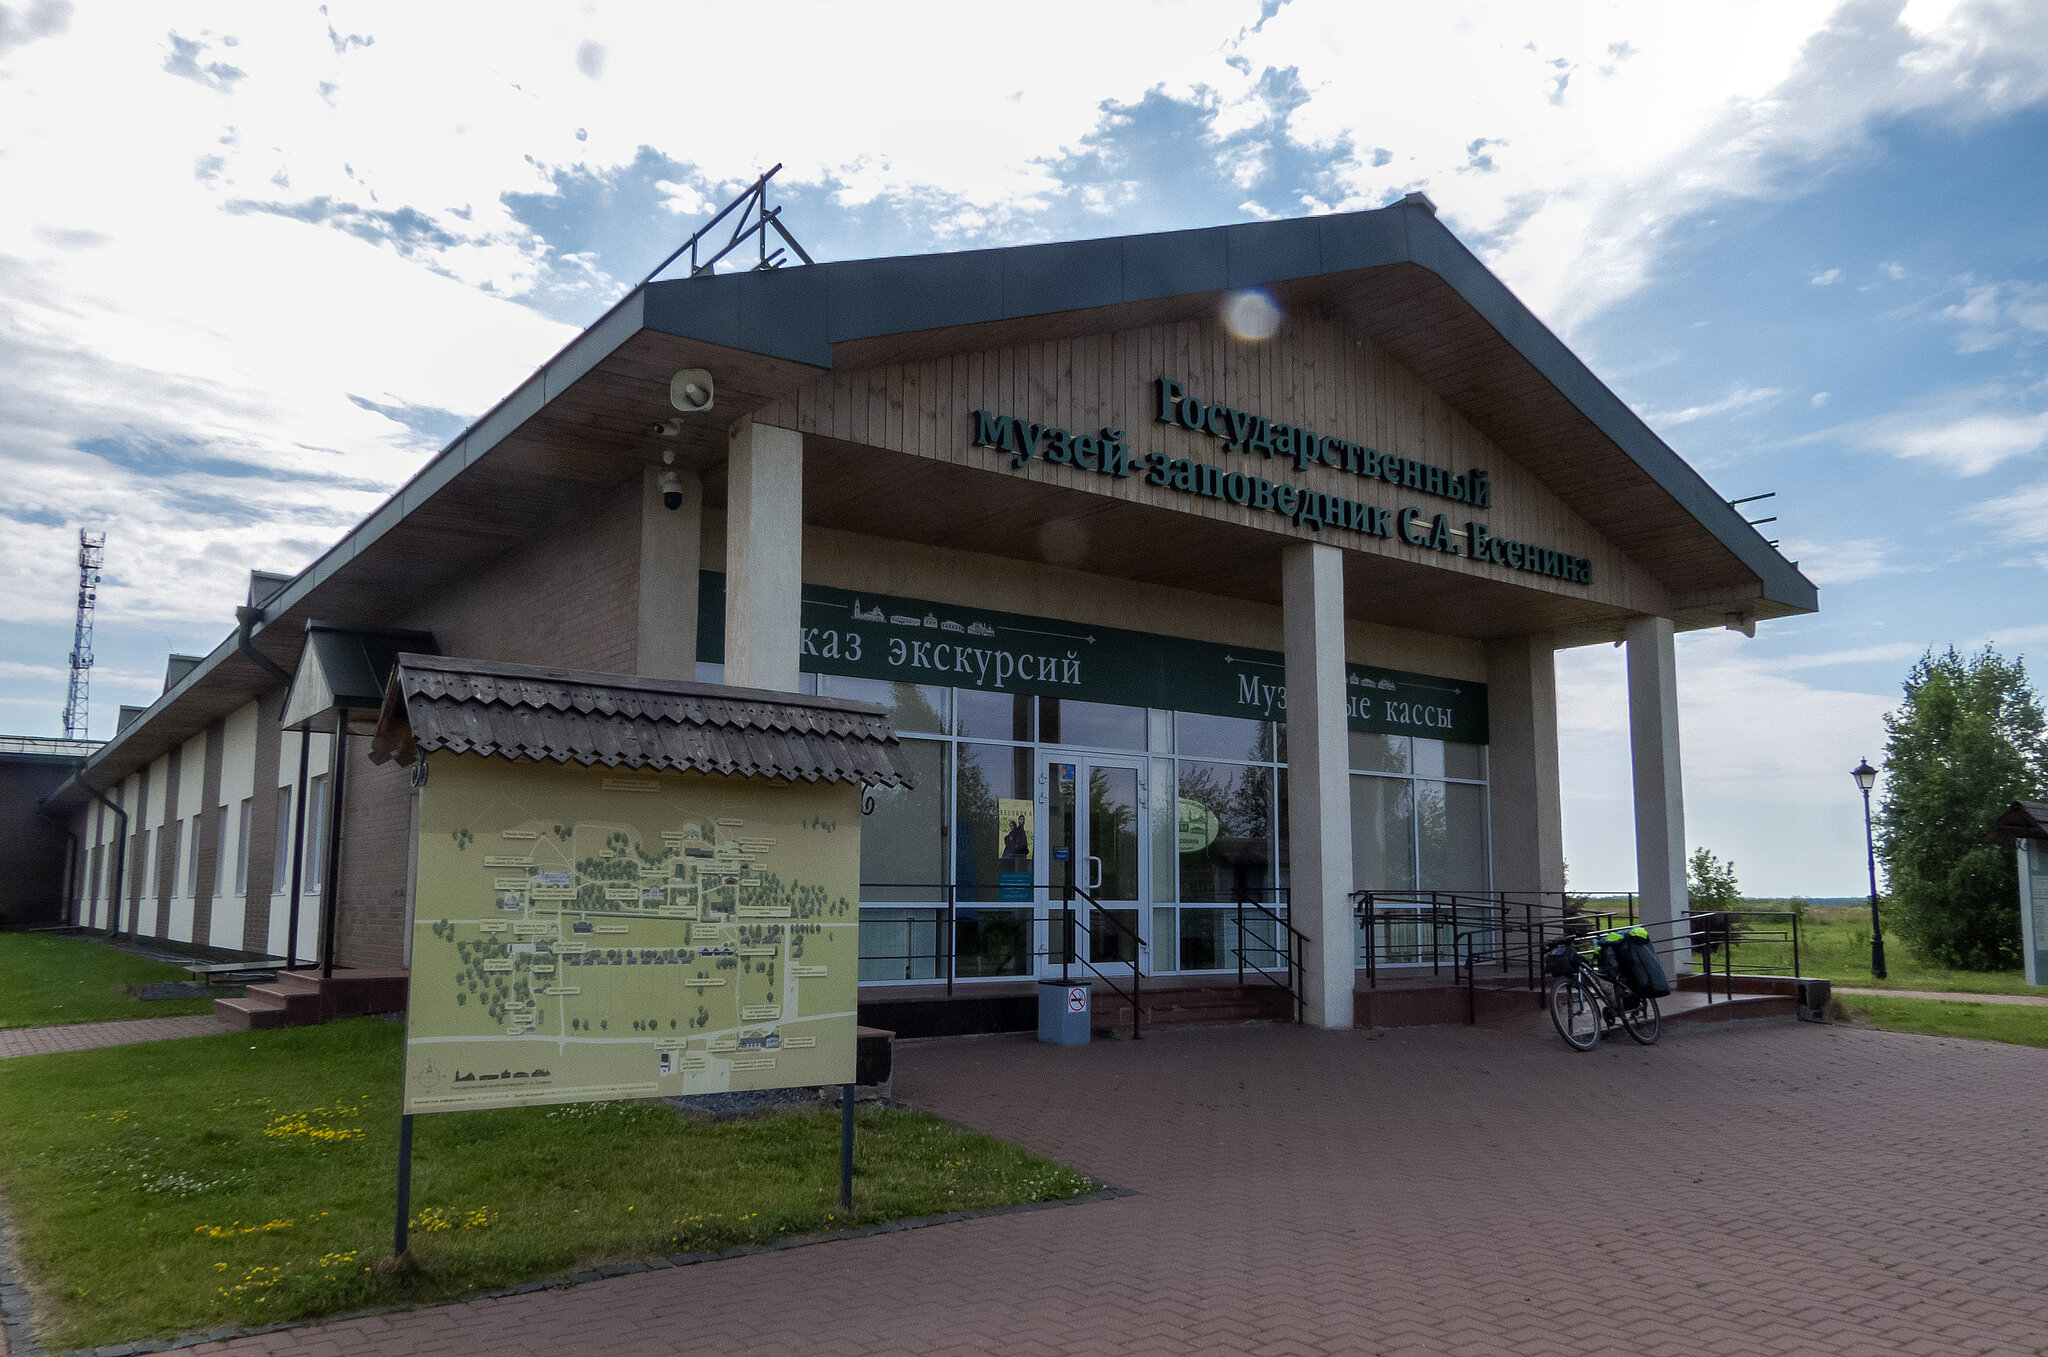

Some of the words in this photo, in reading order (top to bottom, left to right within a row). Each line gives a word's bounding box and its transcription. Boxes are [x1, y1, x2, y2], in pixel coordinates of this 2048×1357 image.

[1157, 377, 1492, 509] Государственный
[1467, 521, 1593, 585] Есенина
[799, 627, 862, 661] каз
[888, 637, 1082, 689] экскурсий
[1384, 699, 1453, 729] кассы
